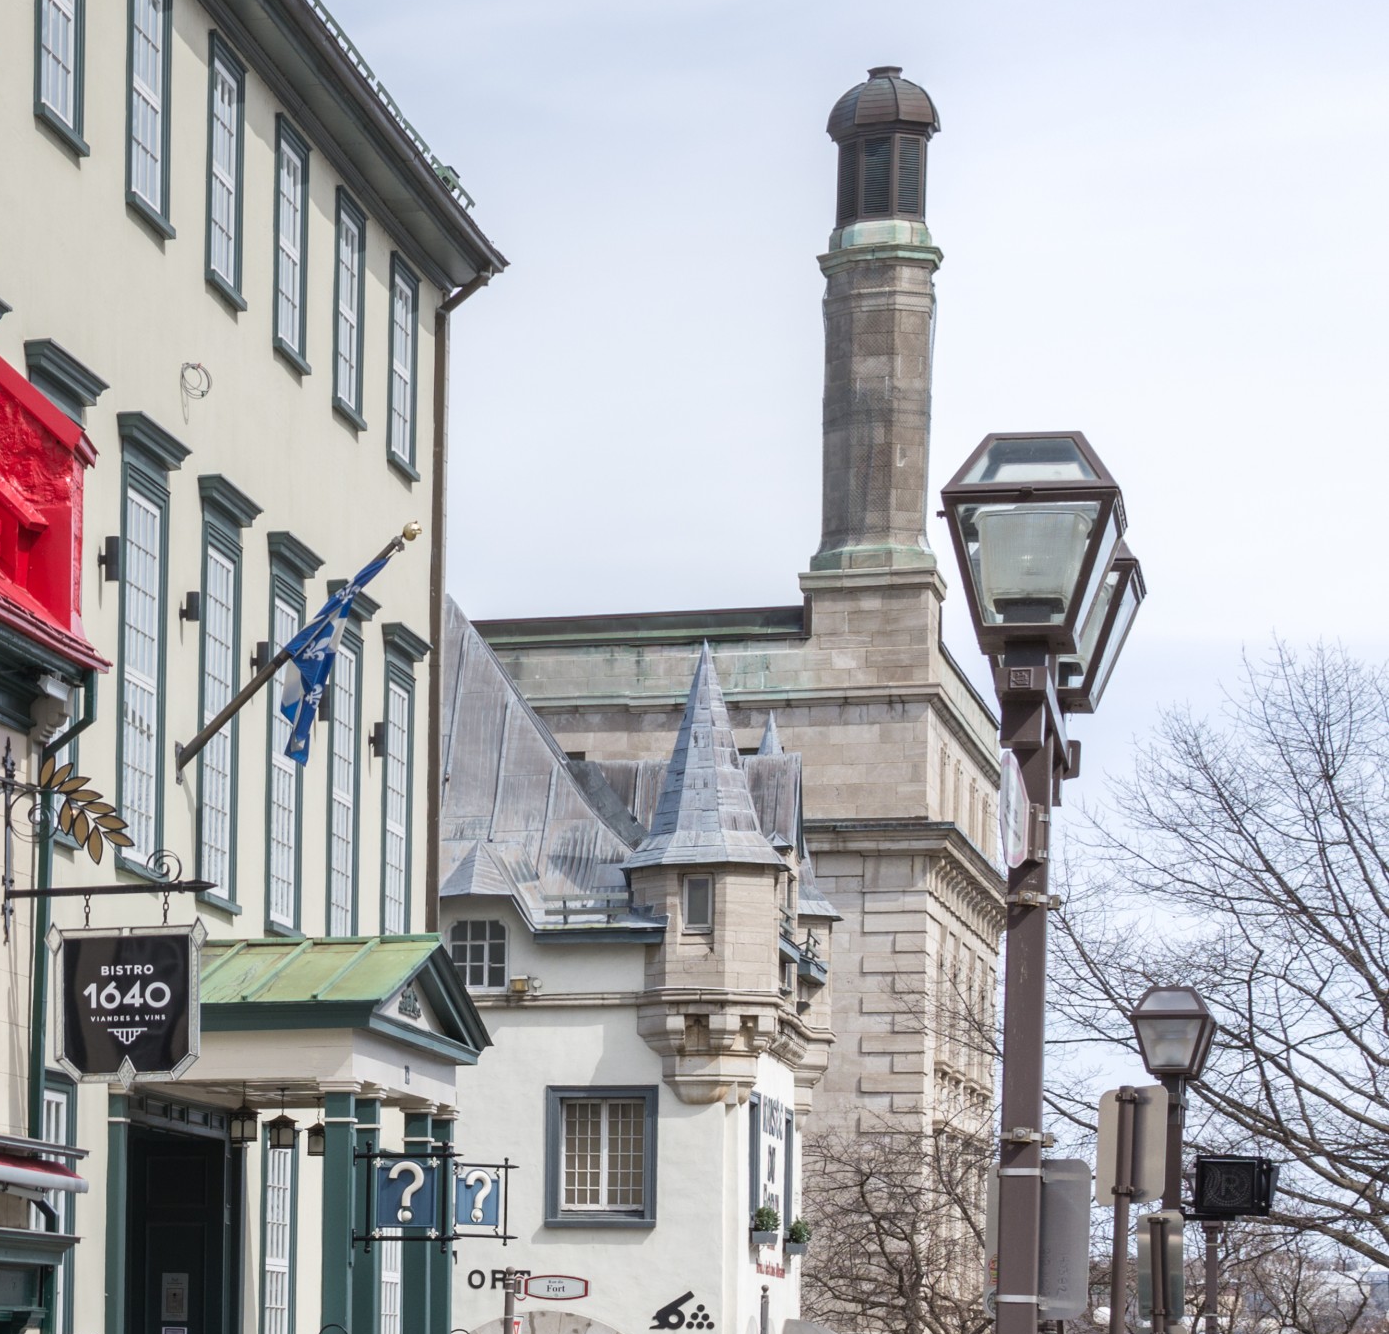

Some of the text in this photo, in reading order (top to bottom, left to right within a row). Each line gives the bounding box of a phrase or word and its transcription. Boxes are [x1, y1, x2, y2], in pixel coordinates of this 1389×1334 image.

[101, 964, 154, 976] BISTRO
[83, 979, 171, 1009] 1640
[546, 1285, 565, 1293] Fort
